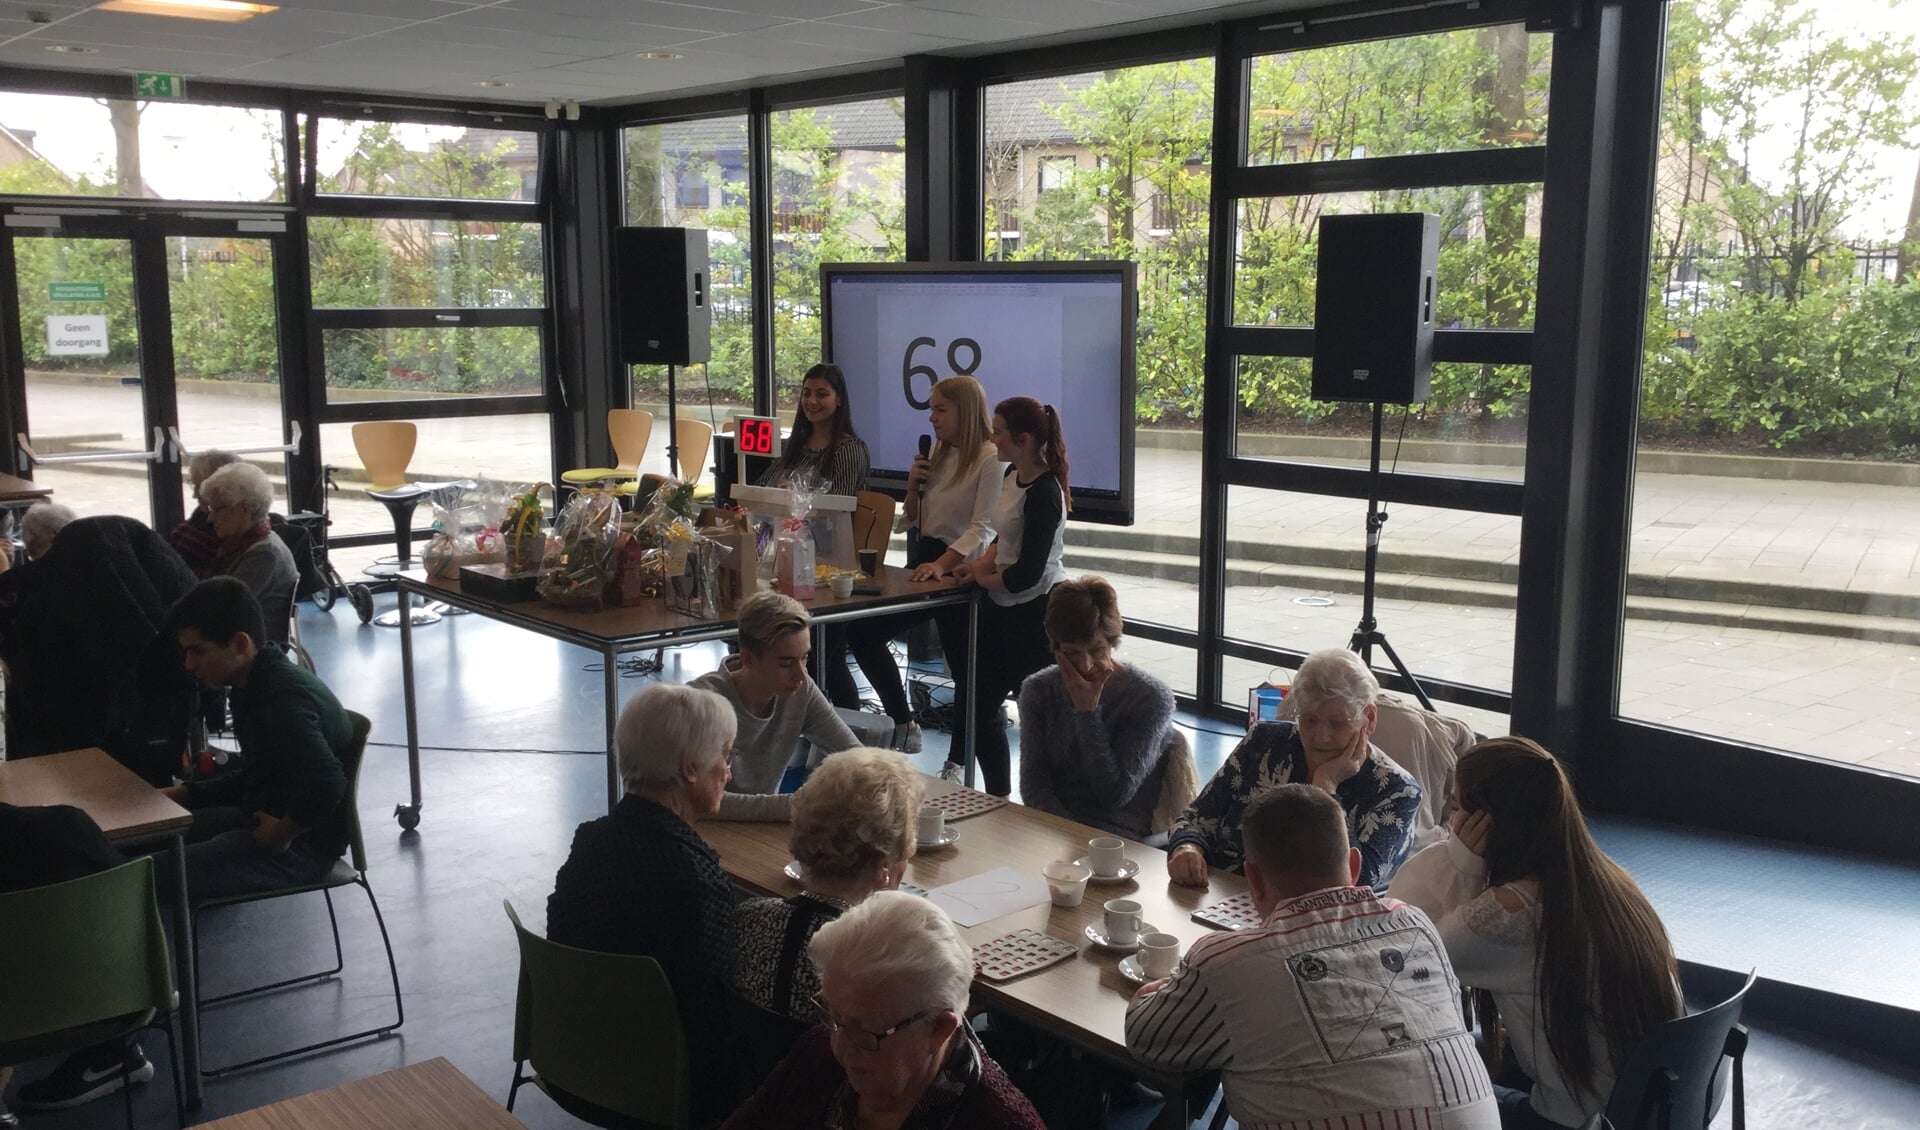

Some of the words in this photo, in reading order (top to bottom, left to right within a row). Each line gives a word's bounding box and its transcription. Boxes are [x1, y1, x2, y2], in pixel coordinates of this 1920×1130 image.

[64, 323, 90, 332] Geen
[55, 338, 101, 348] doorgang
[741, 419, 773, 452] 68
